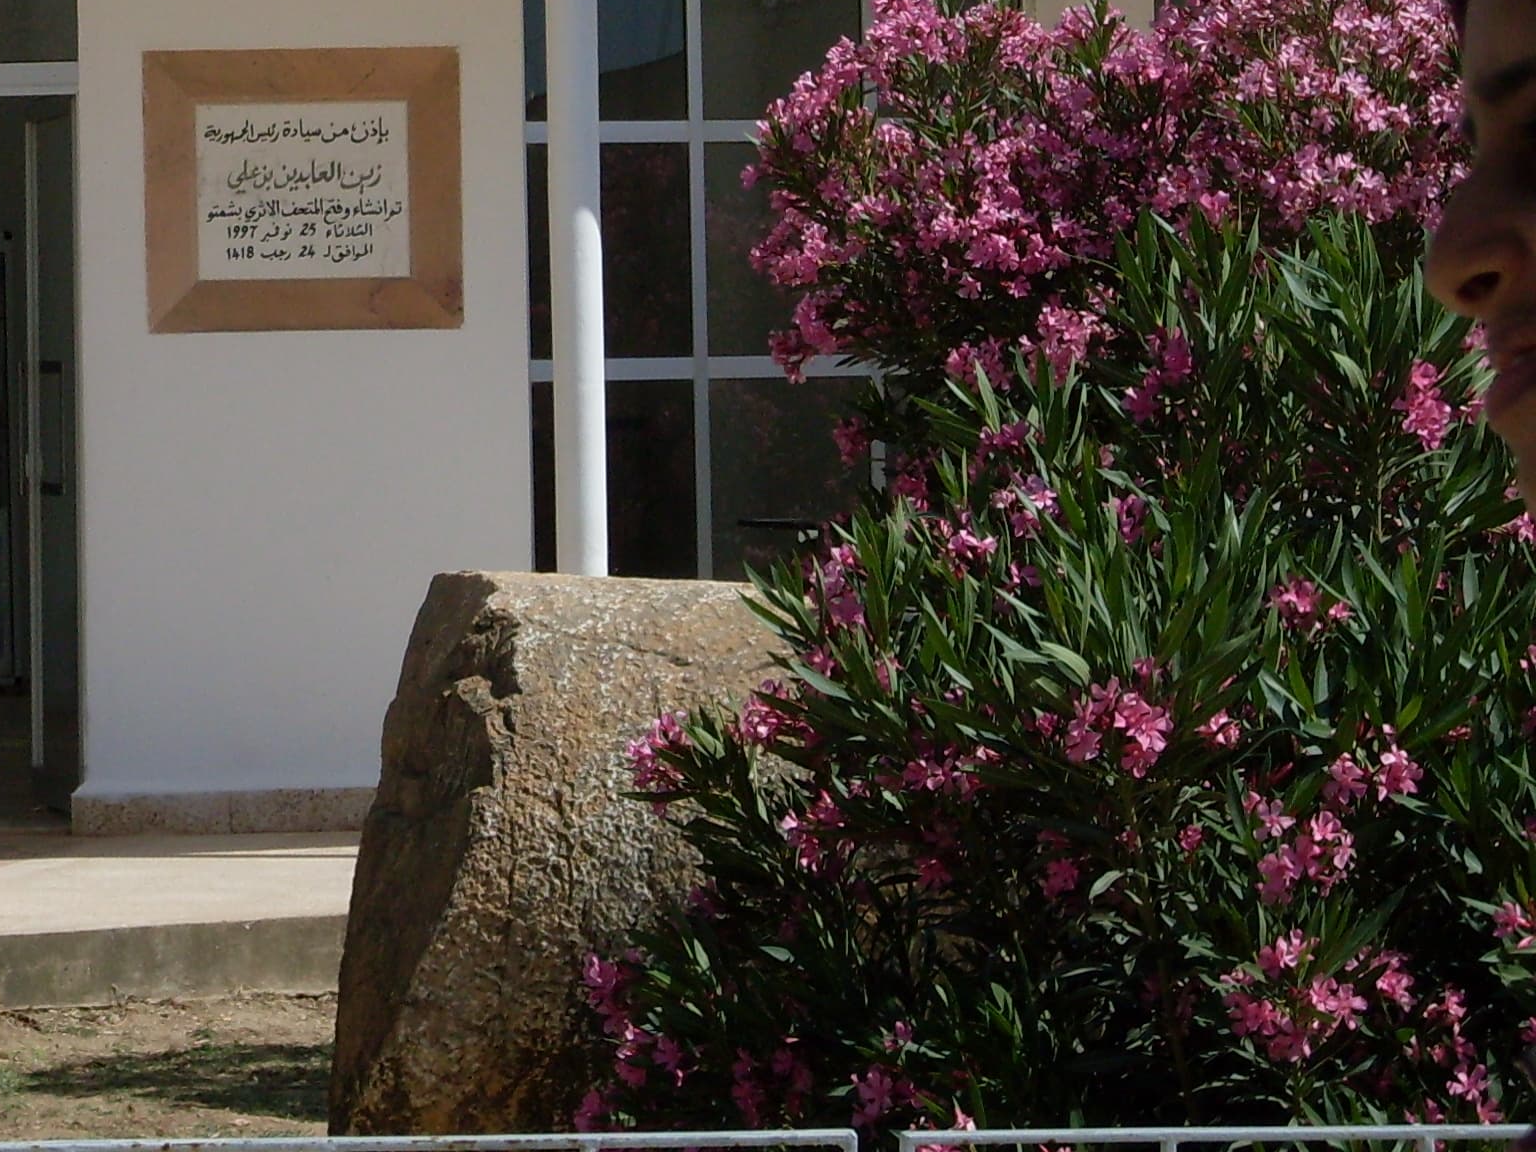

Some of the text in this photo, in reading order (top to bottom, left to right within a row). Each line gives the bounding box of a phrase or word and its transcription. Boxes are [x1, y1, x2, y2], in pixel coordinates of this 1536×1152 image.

[204, 120, 254, 144] الجمهورية
[247, 123, 279, 143] رئيس
[282, 118, 322, 143] سيادة
[321, 122, 349, 143] من
[227, 159, 382, 195] زين العابدين بن علي
[206, 200, 242, 222] بشمتو
[281, 197, 323, 217] المتحف
[324, 199, 352, 224] وفتح
[384, 201, 403, 222] تم
[227, 225, 258, 239] 1997
[299, 222, 317, 237] 25
[326, 222, 372, 238] الثلاثاء
[226, 246, 255, 260] 1418
[260, 248, 291, 261] رجب
[298, 244, 315, 259] 24
[332, 244, 373, 263] الموافق
